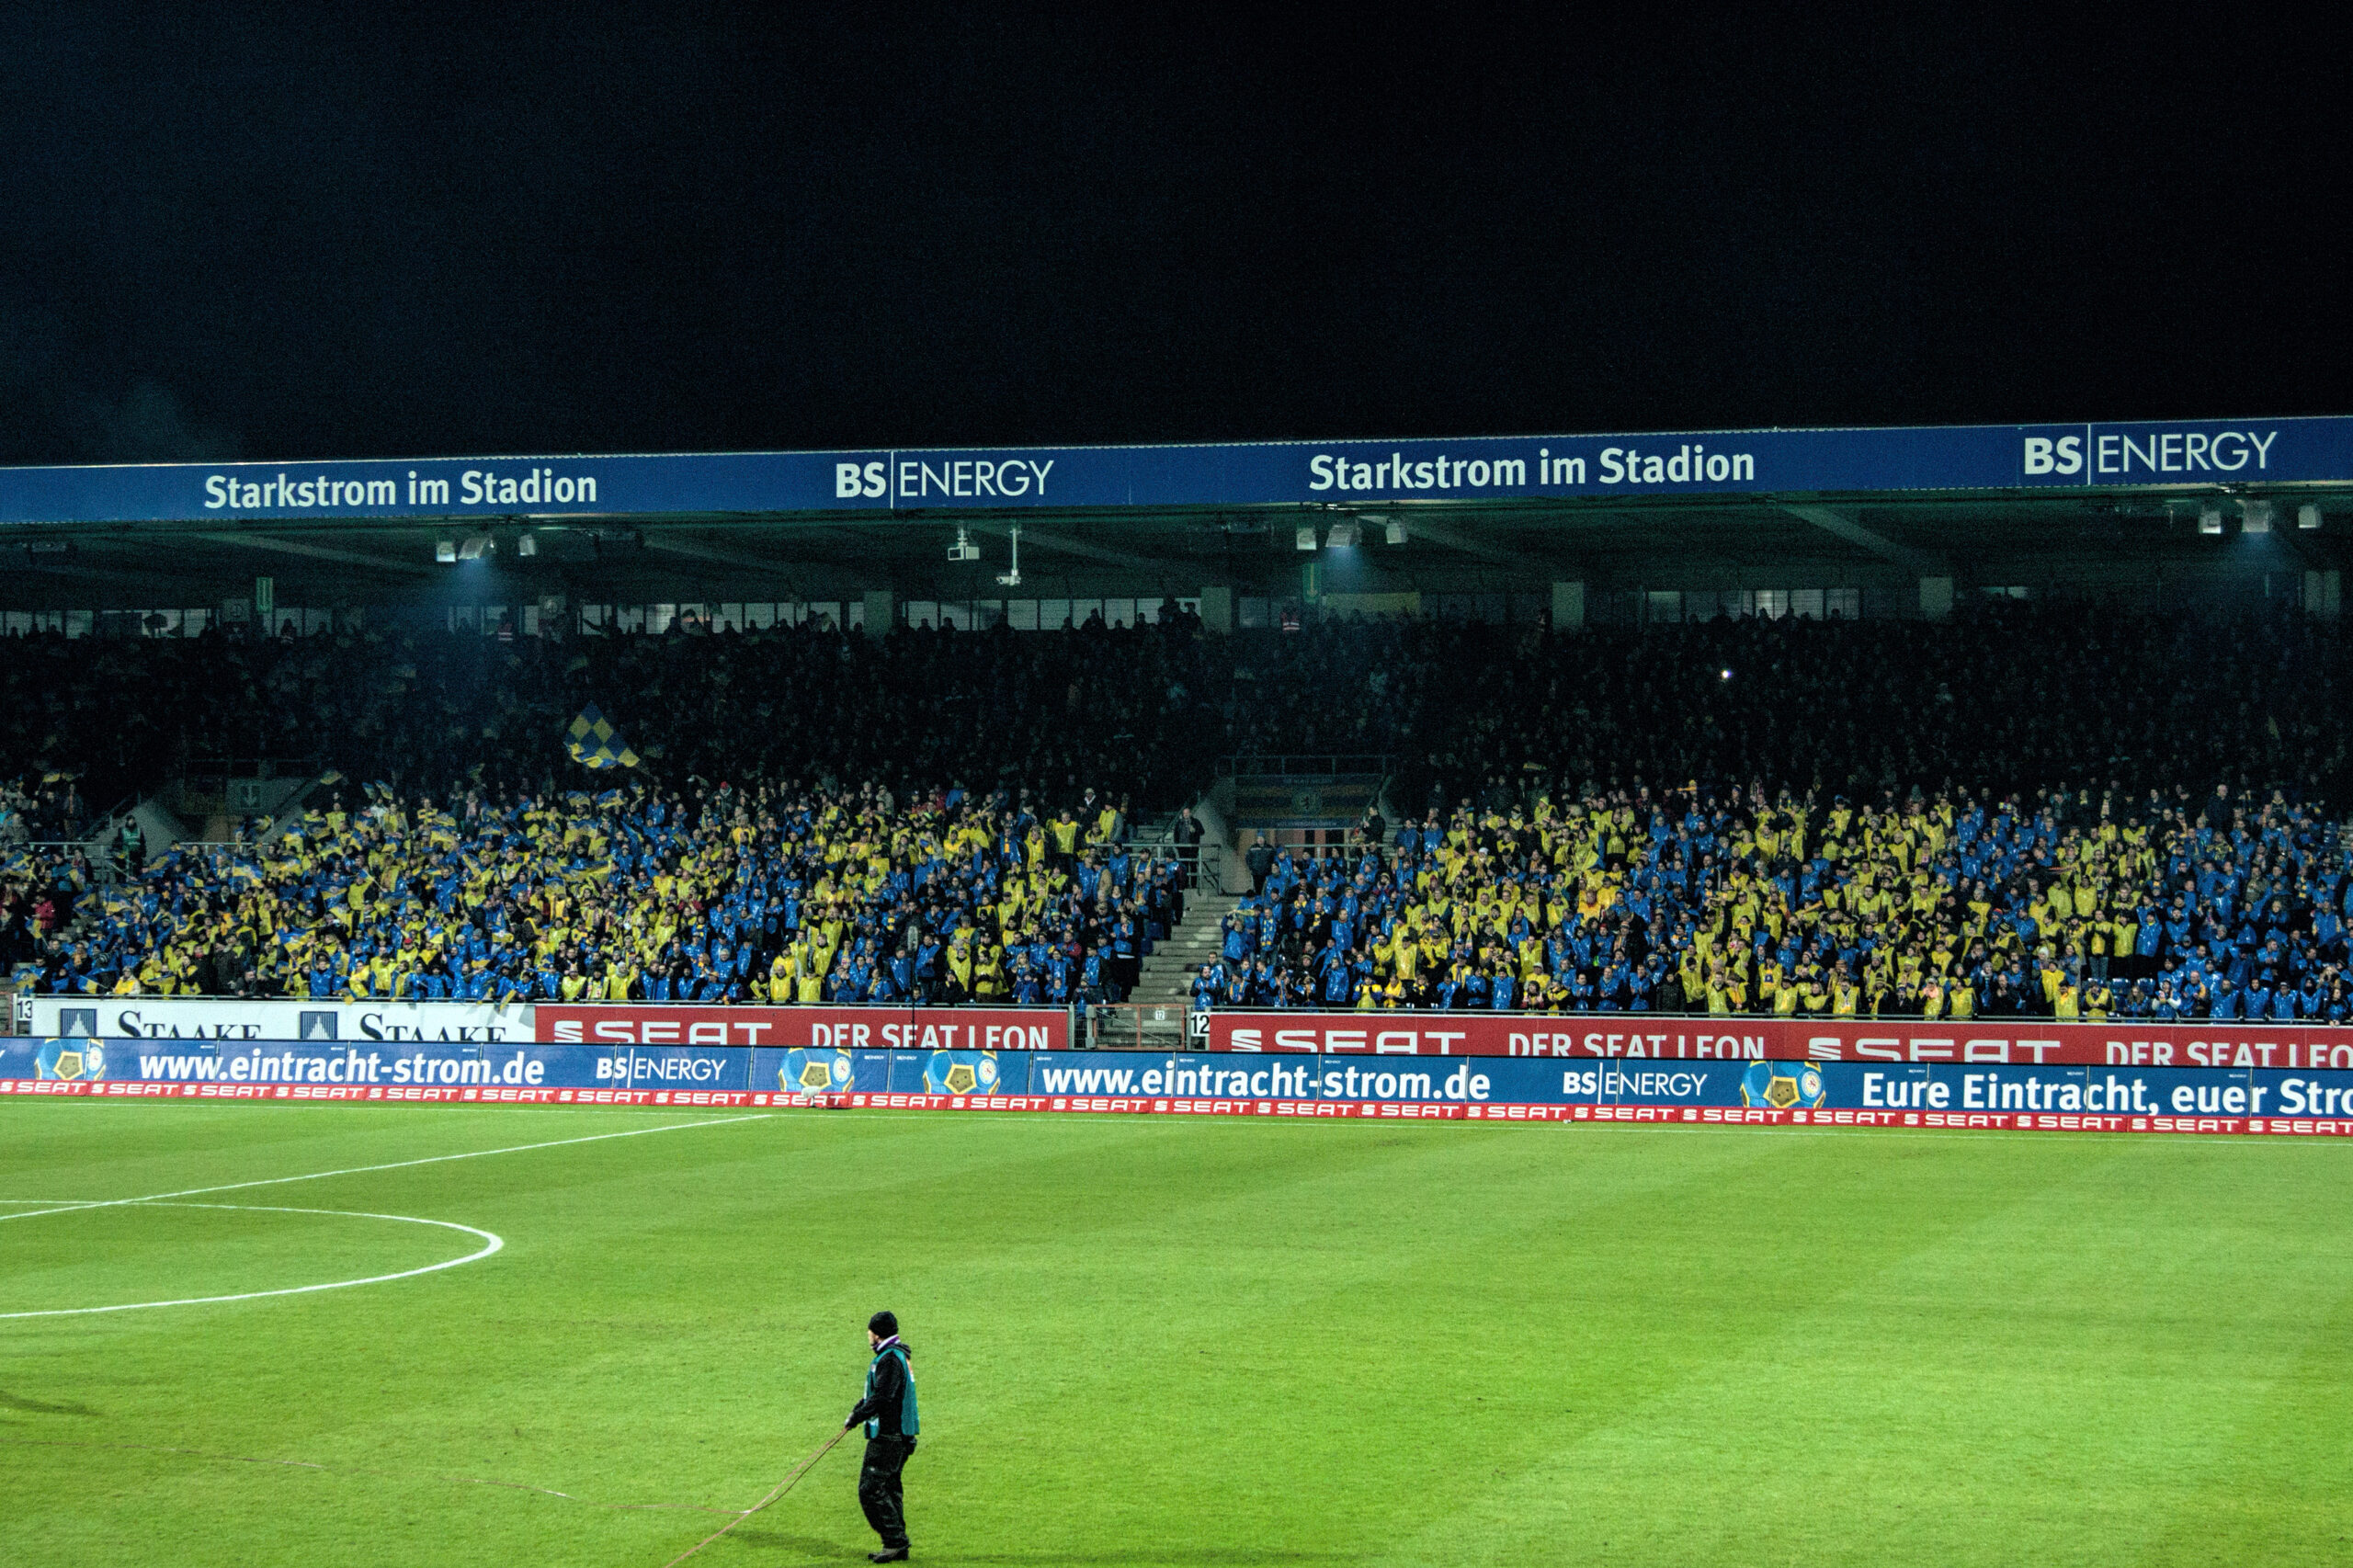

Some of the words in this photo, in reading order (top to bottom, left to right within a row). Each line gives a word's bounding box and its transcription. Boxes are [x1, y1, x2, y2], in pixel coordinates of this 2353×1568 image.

[2098, 431, 2278, 473] ENERGY
[1309, 453, 1526, 491] Starkstrom
[1540, 449, 1586, 486] im
[1599, 444, 1755, 483] Stadion
[900, 460, 1054, 497] ENERGY
[204, 472, 396, 509] Starkstrom
[408, 471, 449, 505] im
[460, 468, 597, 504] Stadion
[17, 1000, 32, 1018] 13
[1191, 1015, 1210, 1034] 12
[595, 1021, 772, 1045] SEAT
[881, 1024, 958, 1048] SEAT
[1275, 1029, 1466, 1054] SEAT
[1583, 1033, 1667, 1058] SEAT
[1855, 1038, 2061, 1063] SEAT
[2187, 1041, 2277, 1067] SEAT
[140, 1048, 544, 1085] www.eintracht-strom.de
[634, 1059, 726, 1080] ENERGY
[1042, 1060, 1491, 1100] www.eintracht-strom.de
[1606, 1072, 1708, 1096] ENERGY
[17, 1082, 86, 1094] SEAT
[108, 1084, 179, 1095] SEAT
[200, 1085, 271, 1096] SEAT
[294, 1087, 364, 1098] SEAT
[386, 1089, 459, 1099] SEAT
[482, 1090, 553, 1101] SEAT
[576, 1092, 649, 1102] SEAT
[675, 1094, 748, 1104] SEAT
[1862, 1073, 1949, 1108] Eure
[1963, 1073, 2160, 1116] Eintracht,
[2171, 1085, 2268, 1113] euer
[871, 1096, 944, 1107] SEAT
[971, 1097, 1046, 1108] SEAT
[1072, 1100, 1146, 1110] SEAT
[1174, 1102, 1250, 1112] SEAT
[1277, 1104, 1354, 1115] SEAT
[1381, 1106, 1460, 1117] SEAT
[1488, 1107, 1566, 1118] SEAT
[1594, 1108, 1674, 1119] SEAT
[1703, 1110, 1784, 1122] SEAT
[1813, 1112, 1895, 1123] SEAT
[1926, 1115, 2007, 1126] SEAT
[2038, 1118, 2122, 1129] SEAT
[2154, 1119, 2239, 1131] SEAT
[2270, 1121, 2353, 1133] SEAT
